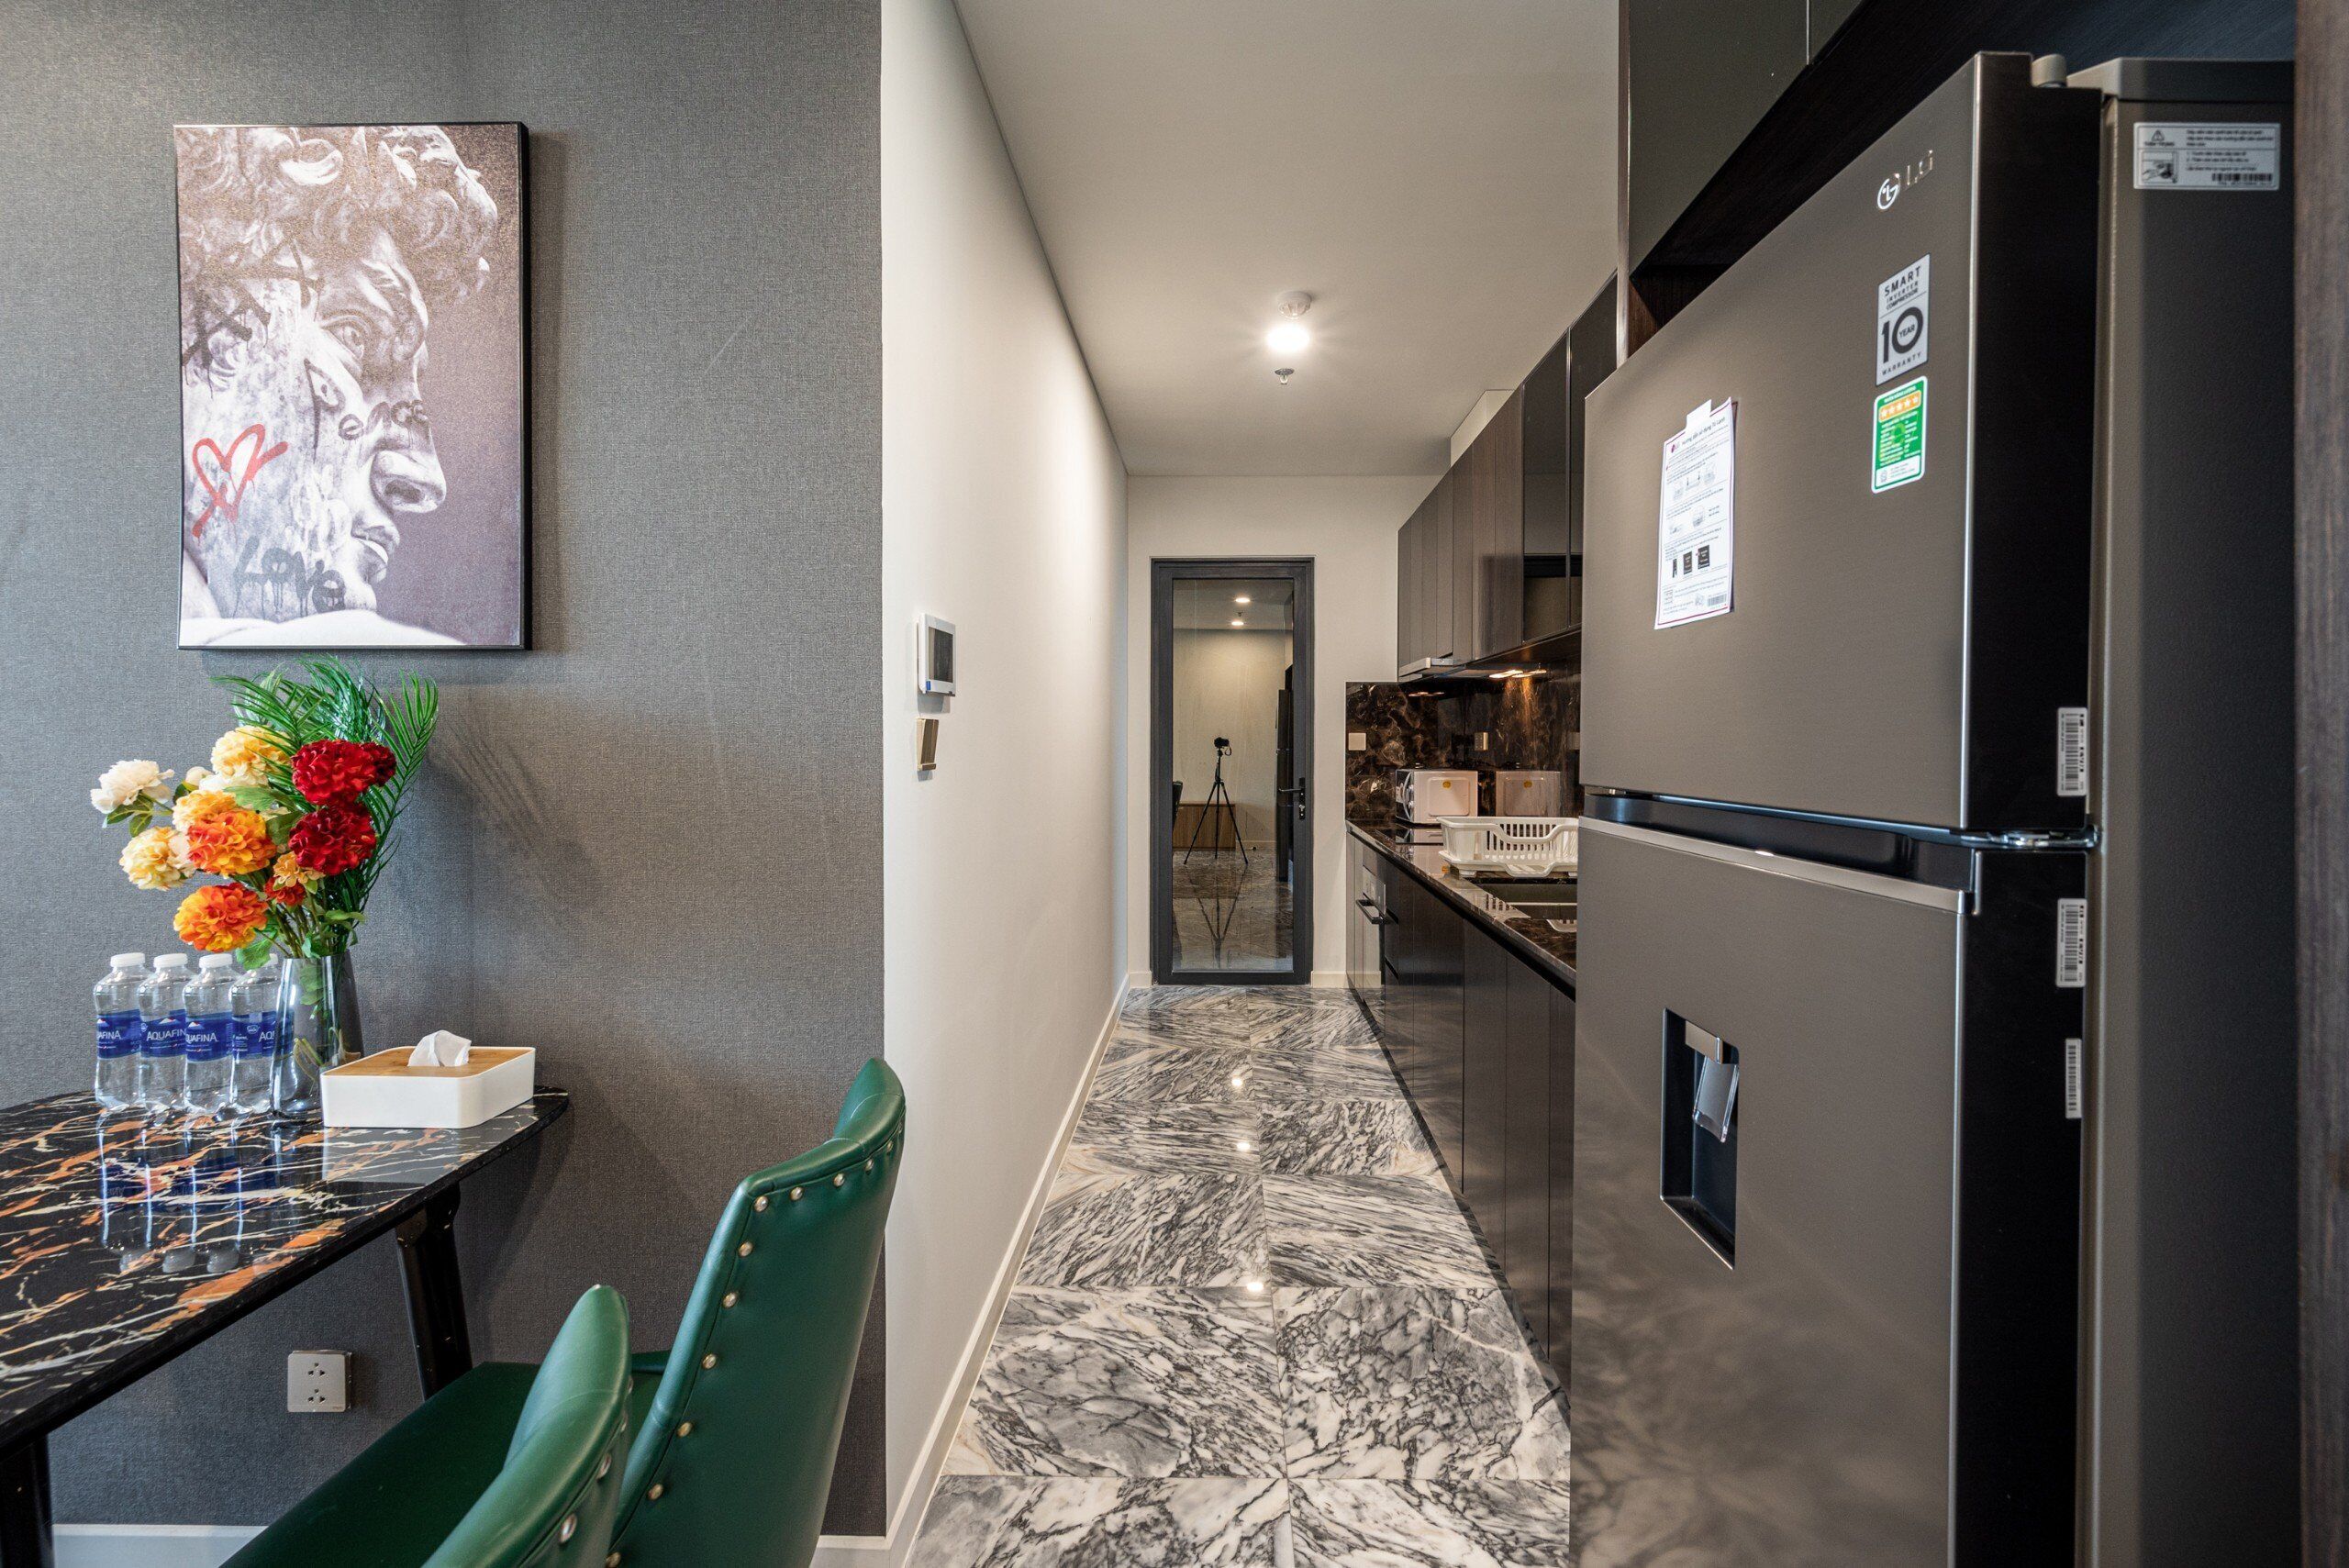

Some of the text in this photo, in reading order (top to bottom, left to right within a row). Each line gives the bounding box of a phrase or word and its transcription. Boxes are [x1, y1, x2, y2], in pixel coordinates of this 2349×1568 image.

[1884, 266, 1920, 296] SMART
[1887, 281, 1919, 303] INVERTER
[1881, 306, 1924, 364] 10
[1898, 324, 1915, 338] YEAR
[1882, 351, 1921, 375] WARRANTY
